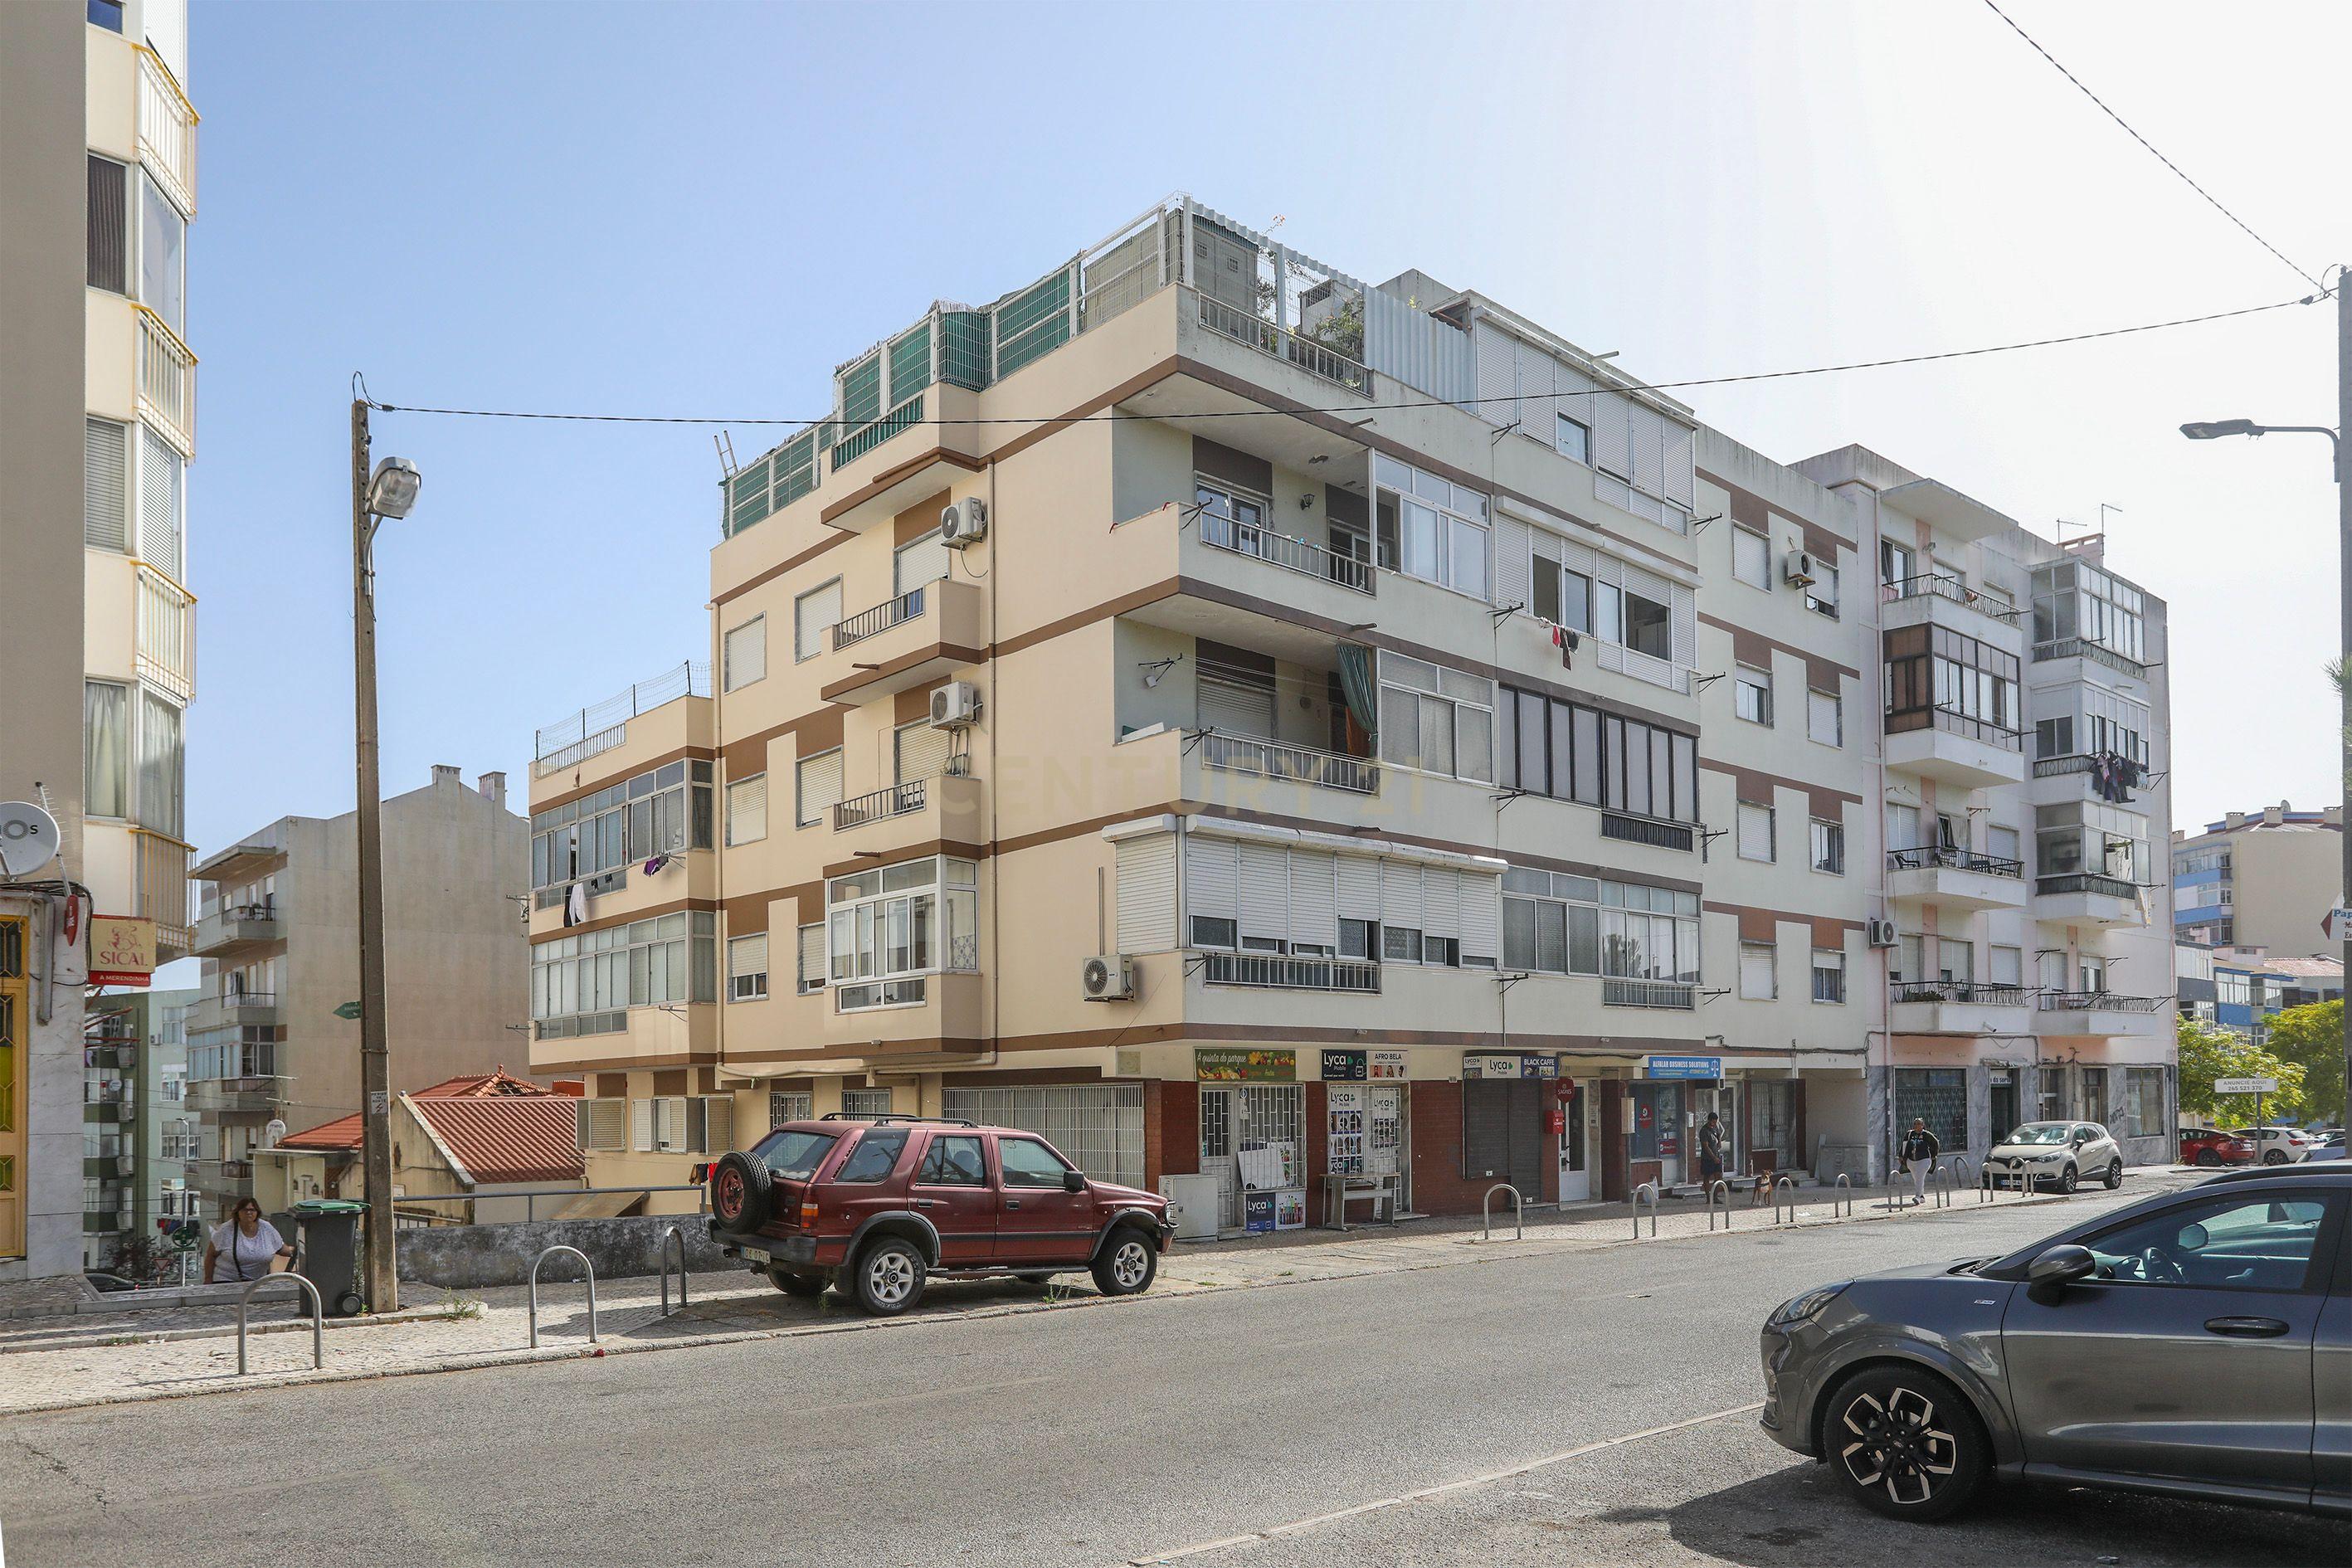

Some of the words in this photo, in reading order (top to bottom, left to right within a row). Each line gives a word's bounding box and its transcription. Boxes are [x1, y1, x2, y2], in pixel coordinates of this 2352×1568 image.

[1226, 1054, 1247, 1065] parque
[1323, 1053, 1346, 1067] Lyca
[1489, 1059, 1507, 1072] Lyca
[1330, 1092, 1350, 1104] Lyca
[1248, 1200, 1267, 1212] Lyca
